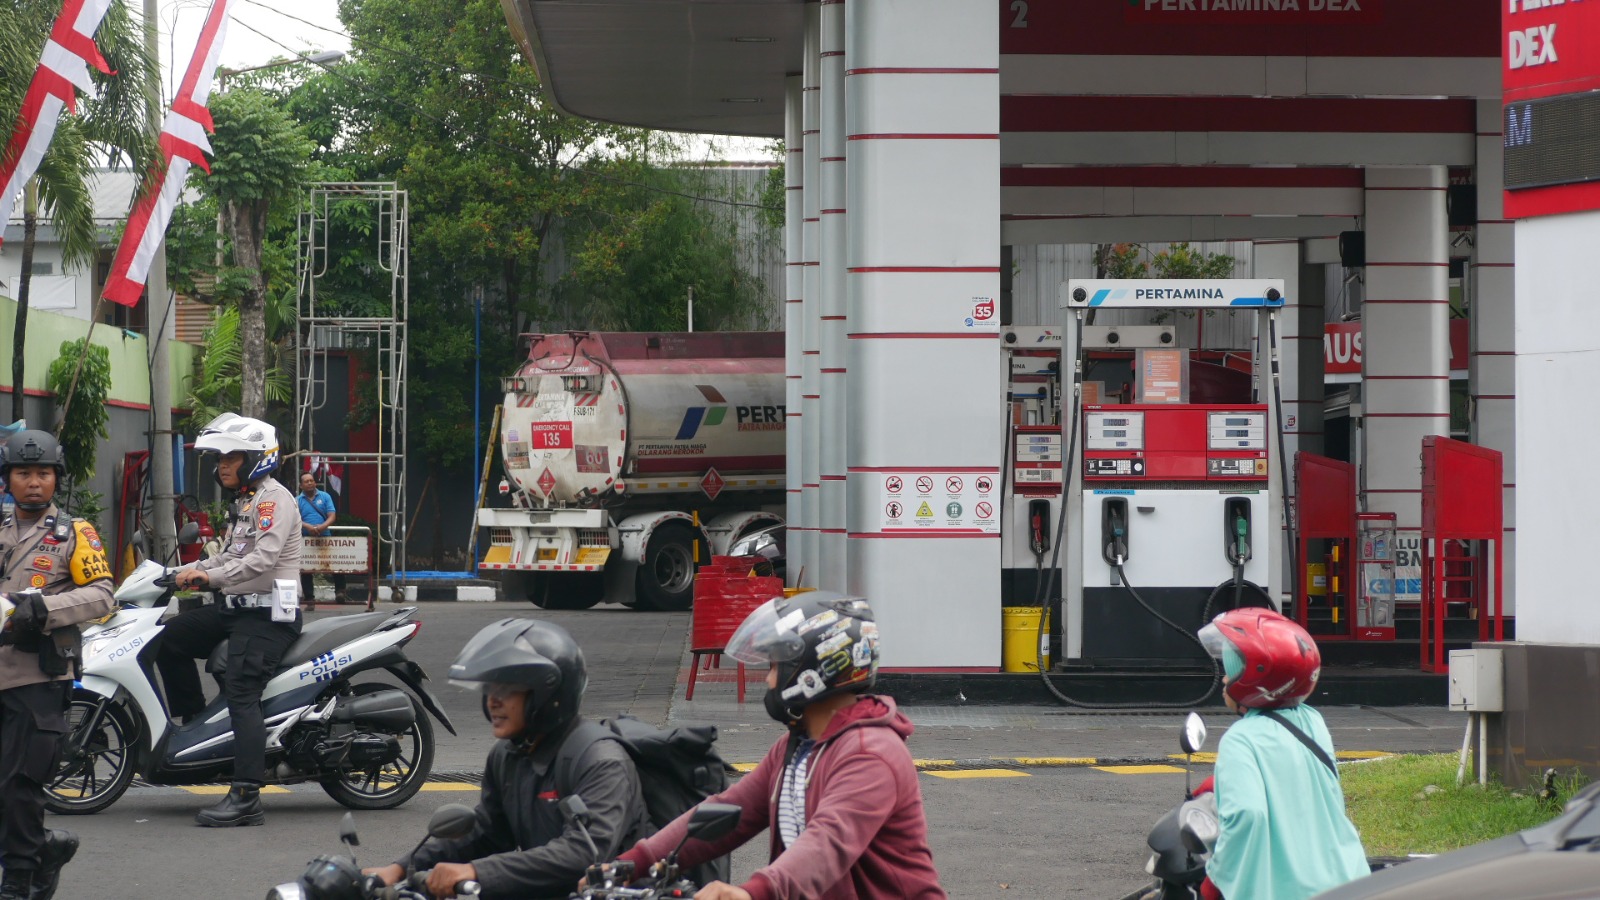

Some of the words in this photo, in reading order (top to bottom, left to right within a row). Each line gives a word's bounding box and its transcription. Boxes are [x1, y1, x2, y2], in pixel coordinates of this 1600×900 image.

[1010, 0, 1028, 28] 2
[1144, 0, 1300, 11] PERTAMINA
[1508, 23, 1558, 69] DEX
[1135, 288, 1224, 299] PERTAMINA
[1324, 331, 1361, 363] MUS
[736, 405, 786, 423] PERT
[543, 432, 560, 446] 135
[304, 539, 356, 547] PERHATIAN
[108, 636, 144, 662] POLISI
[299, 654, 353, 680] POLISI
